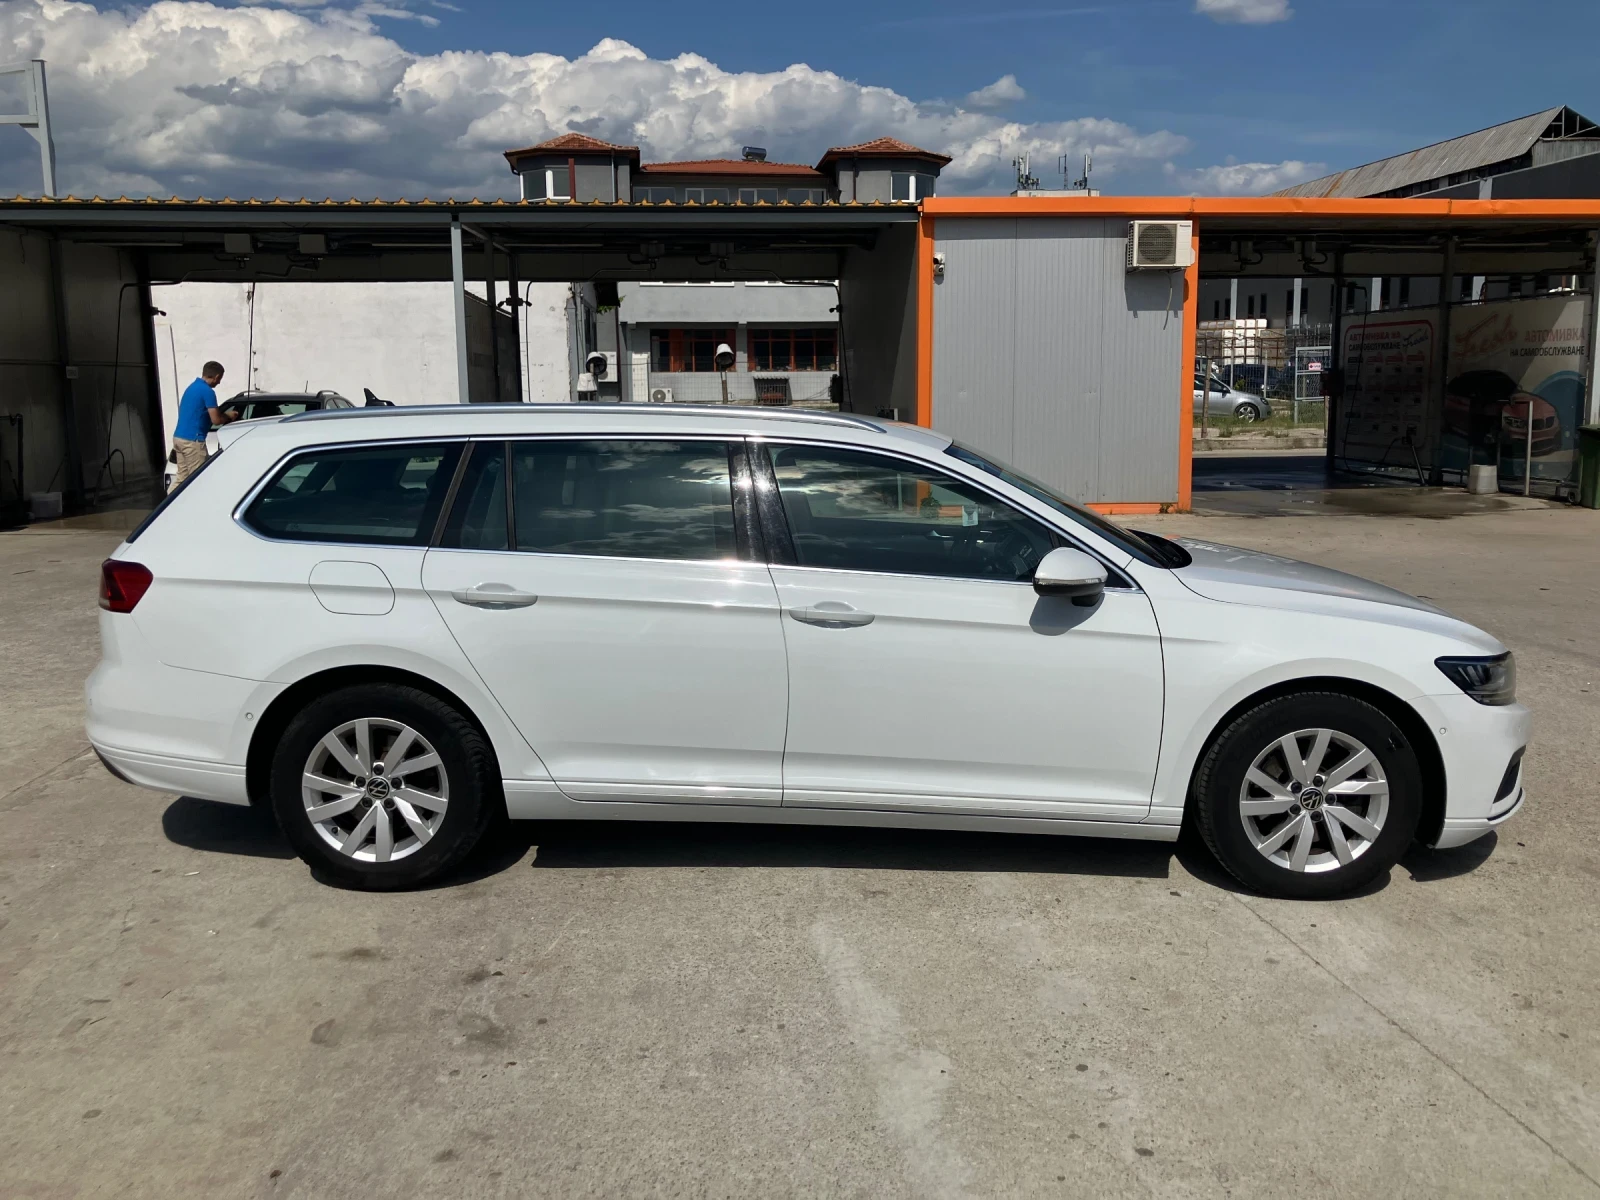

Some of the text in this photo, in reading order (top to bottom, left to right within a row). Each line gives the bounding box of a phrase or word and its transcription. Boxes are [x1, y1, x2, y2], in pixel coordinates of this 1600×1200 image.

[1524, 327, 1585, 343] АВТОМИВКА
[1349, 342, 1400, 351] САМОБСЛУЖВАНЕ
[1510, 346, 1585, 357] НА САМООБСЛУЖВАНЕ
